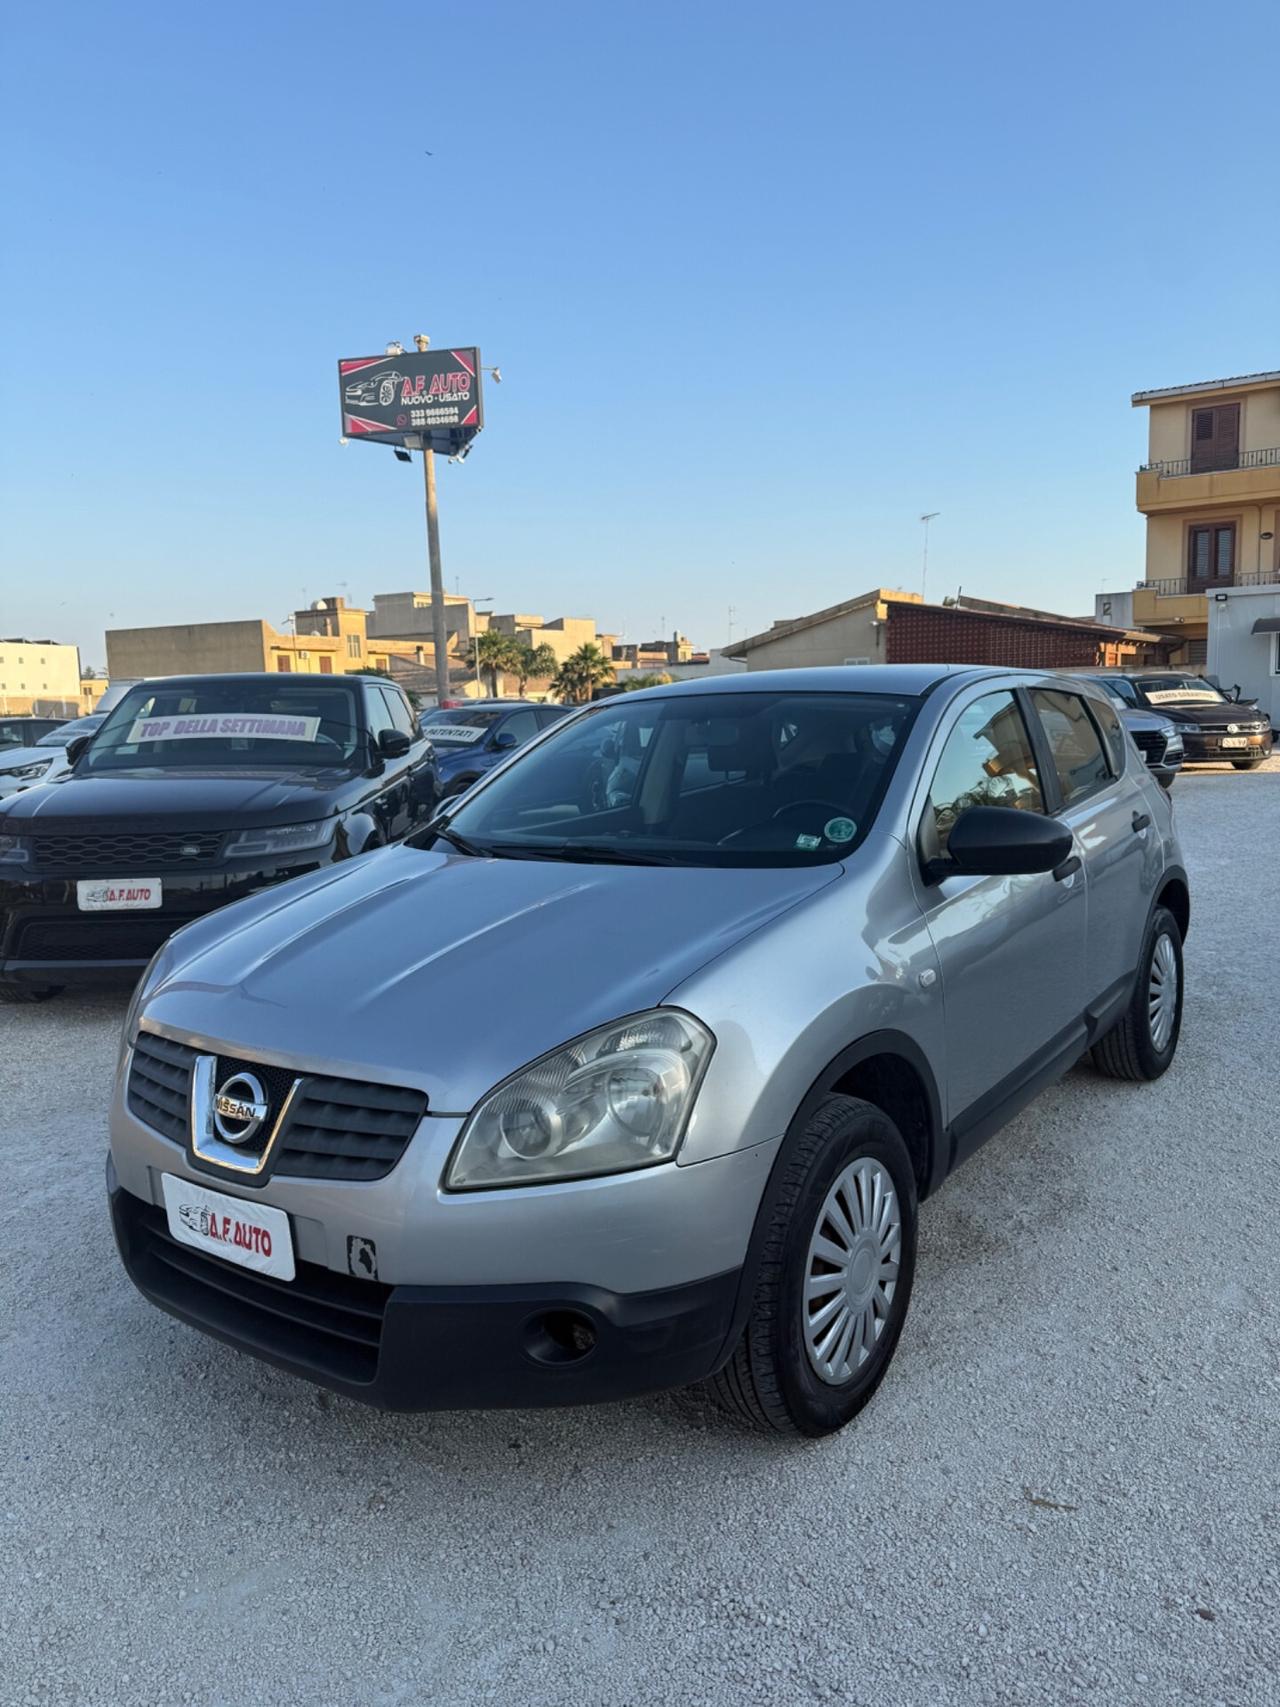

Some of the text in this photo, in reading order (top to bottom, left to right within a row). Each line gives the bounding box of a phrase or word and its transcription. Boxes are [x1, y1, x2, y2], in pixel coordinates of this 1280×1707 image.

[429, 372, 471, 394] AUTO
[401, 394, 433, 406] NUOVO
[439, 391, 470, 402] USATO
[141, 718, 307, 737] TOP DELLA SETTIMANA
[126, 888, 152, 901] AUTO
[216, 1095, 256, 1118] NISSAN
[233, 1221, 272, 1257] AUTO
